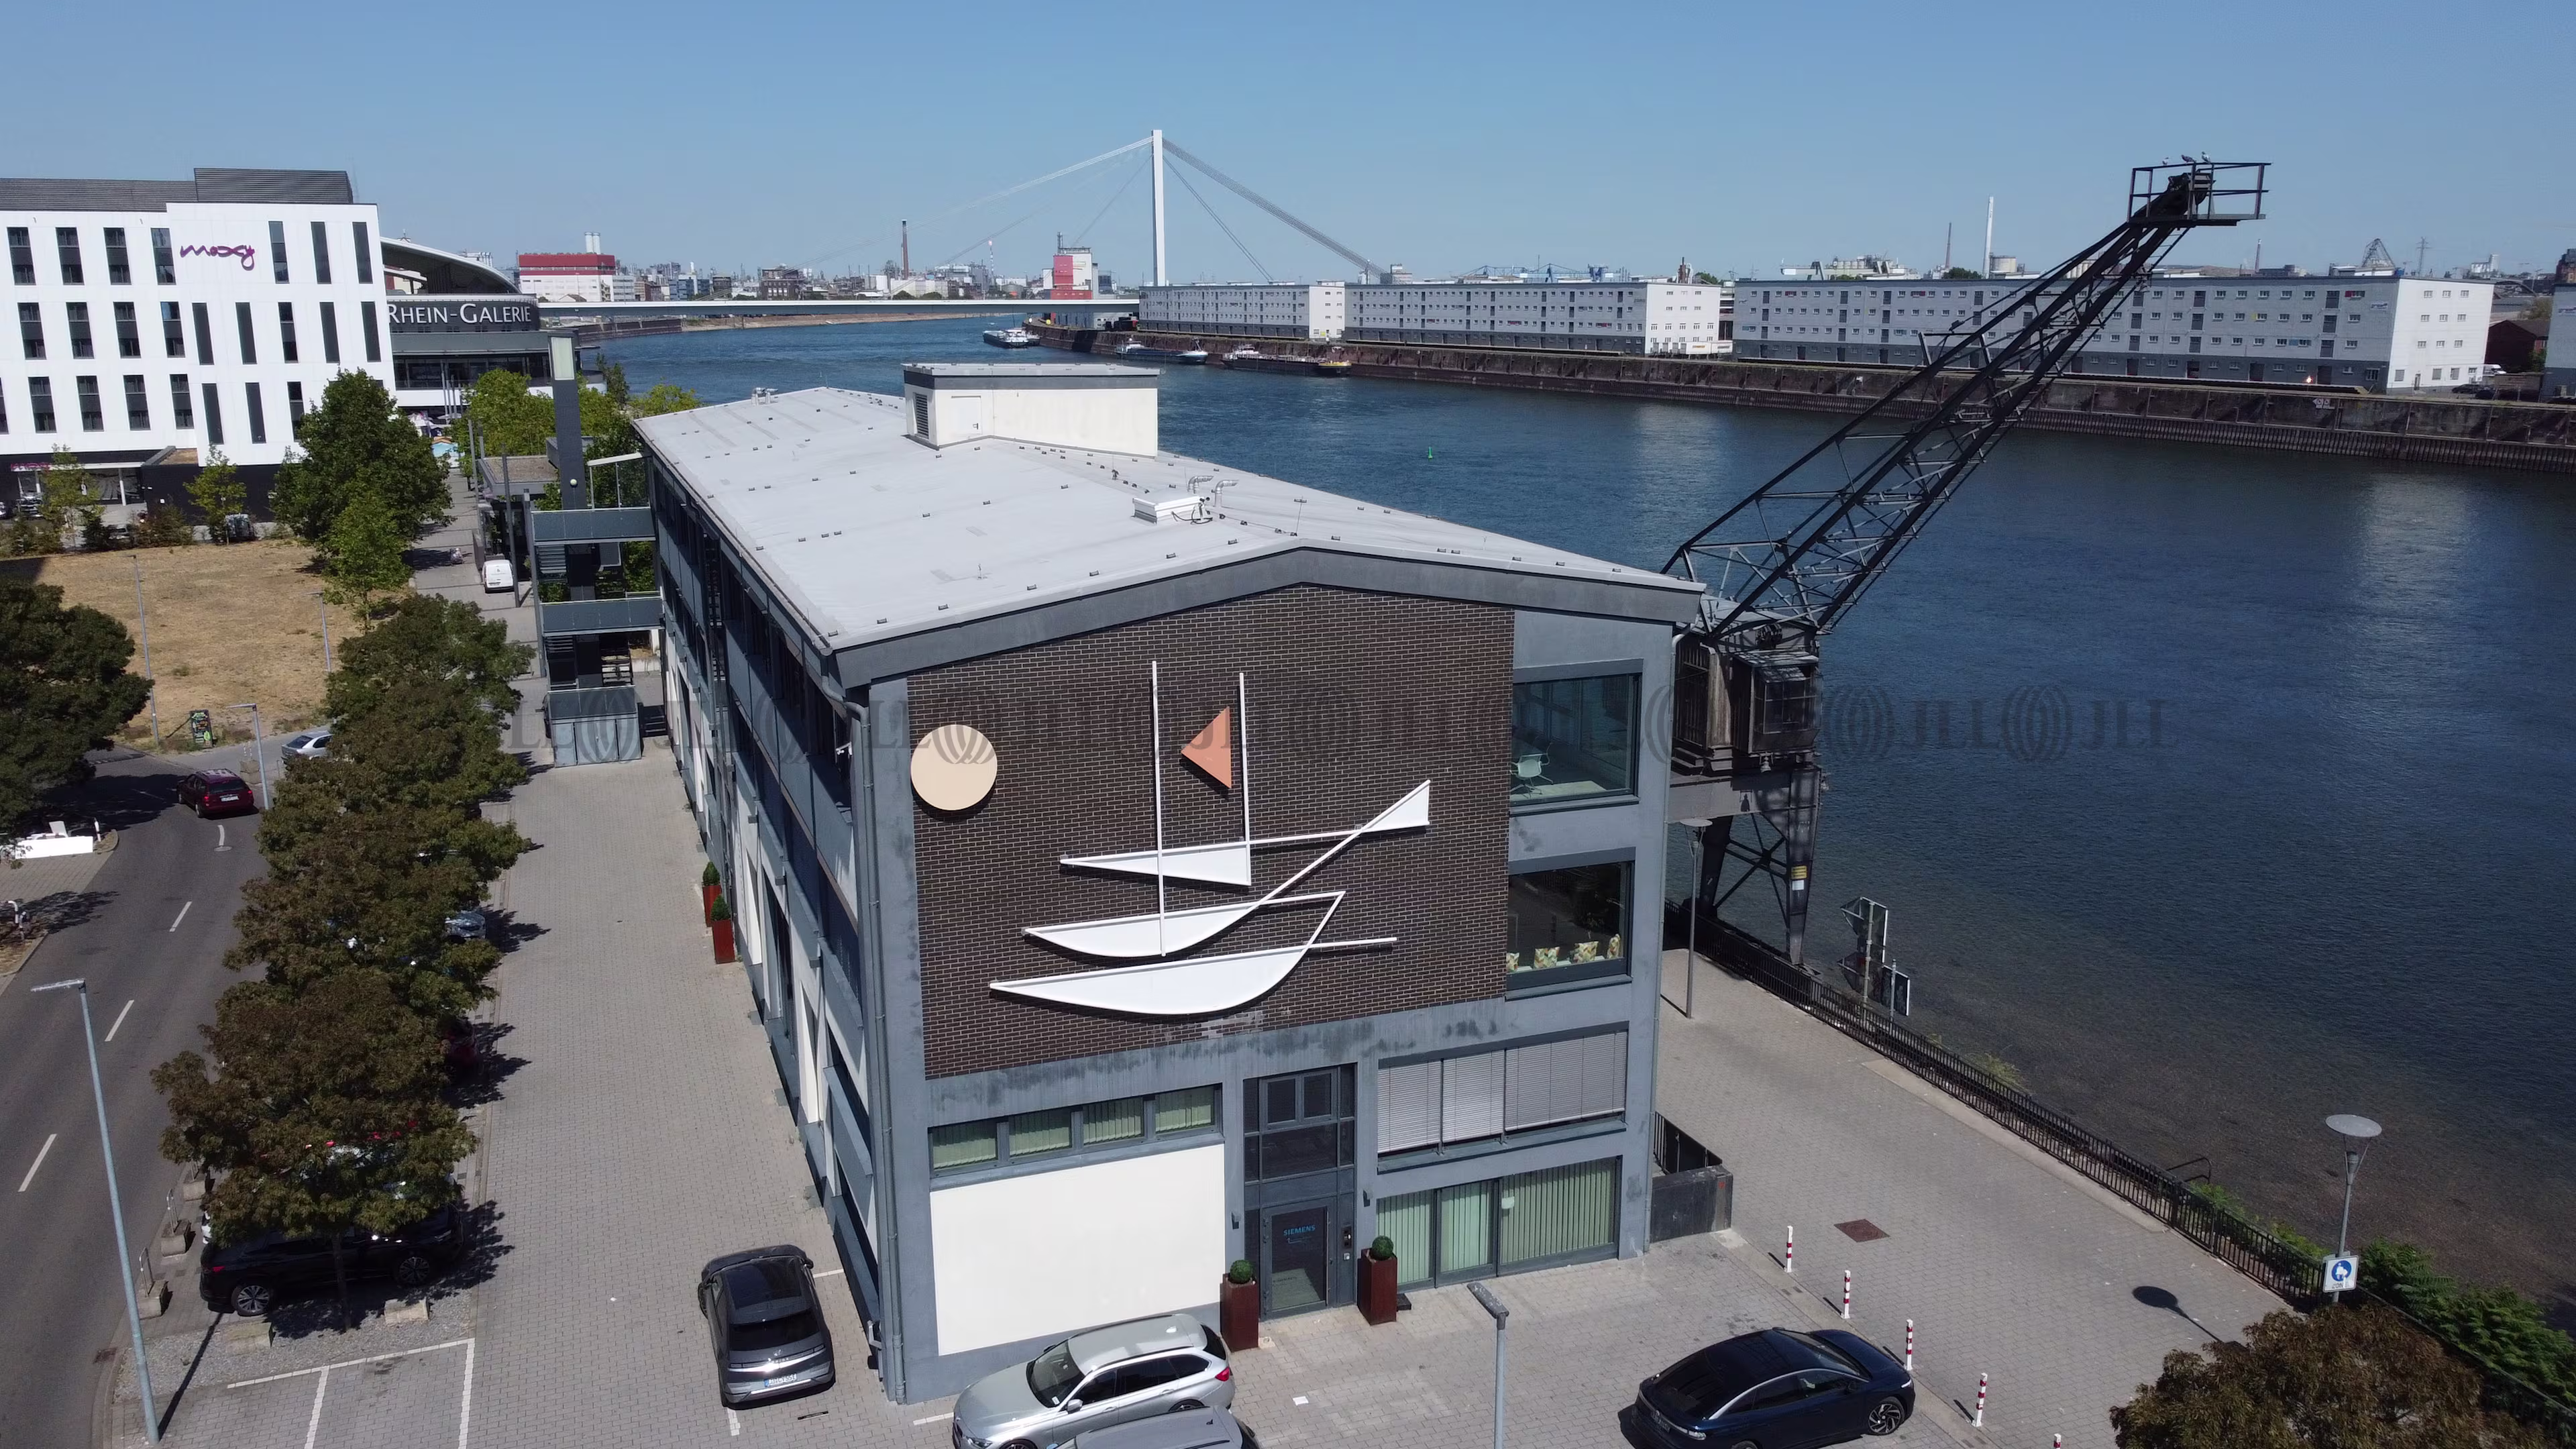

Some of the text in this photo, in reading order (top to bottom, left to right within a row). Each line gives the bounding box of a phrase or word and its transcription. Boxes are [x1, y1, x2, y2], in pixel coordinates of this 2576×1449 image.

[180, 245, 255, 271] moxy
[388, 303, 531, 323] RHEIN-GALERIE
[1283, 1225, 1316, 1236] SIEMENS
